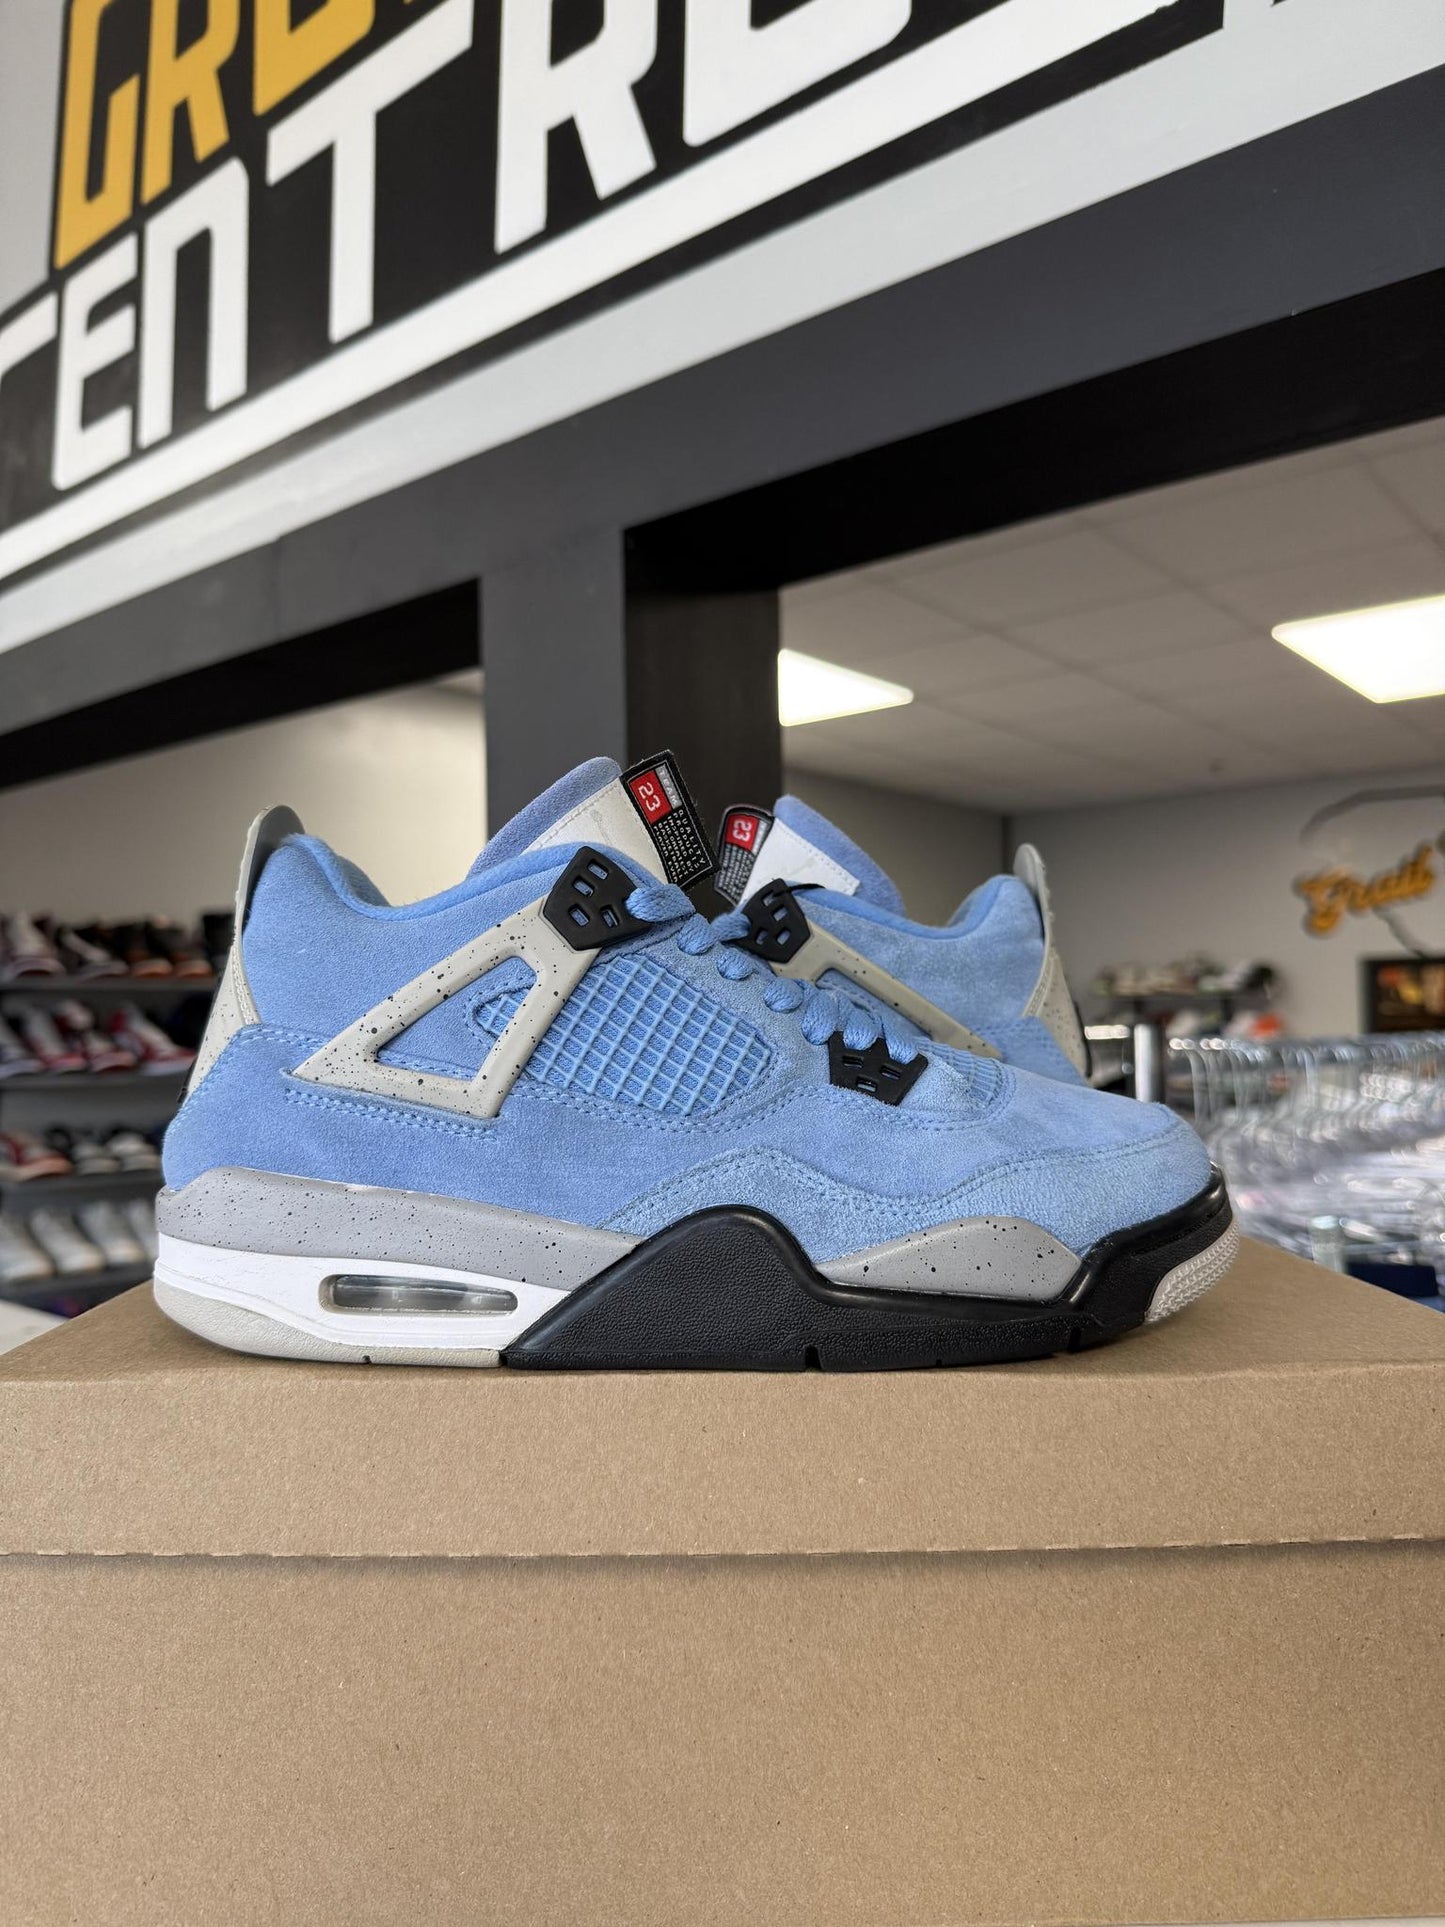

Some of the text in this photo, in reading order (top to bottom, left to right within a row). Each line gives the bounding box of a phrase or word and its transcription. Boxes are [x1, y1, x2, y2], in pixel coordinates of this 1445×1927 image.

[637, 781, 661, 812] 23
[657, 768, 679, 806] TEAM
[651, 825, 669, 857] PLAYER
[656, 822, 683, 879] BASKETBALL
[666, 815, 688, 857] INSPIRED
[671, 811, 700, 869] PRODUCTS
[676, 808, 706, 865] QUALITY
[732, 820, 752, 842] 23
